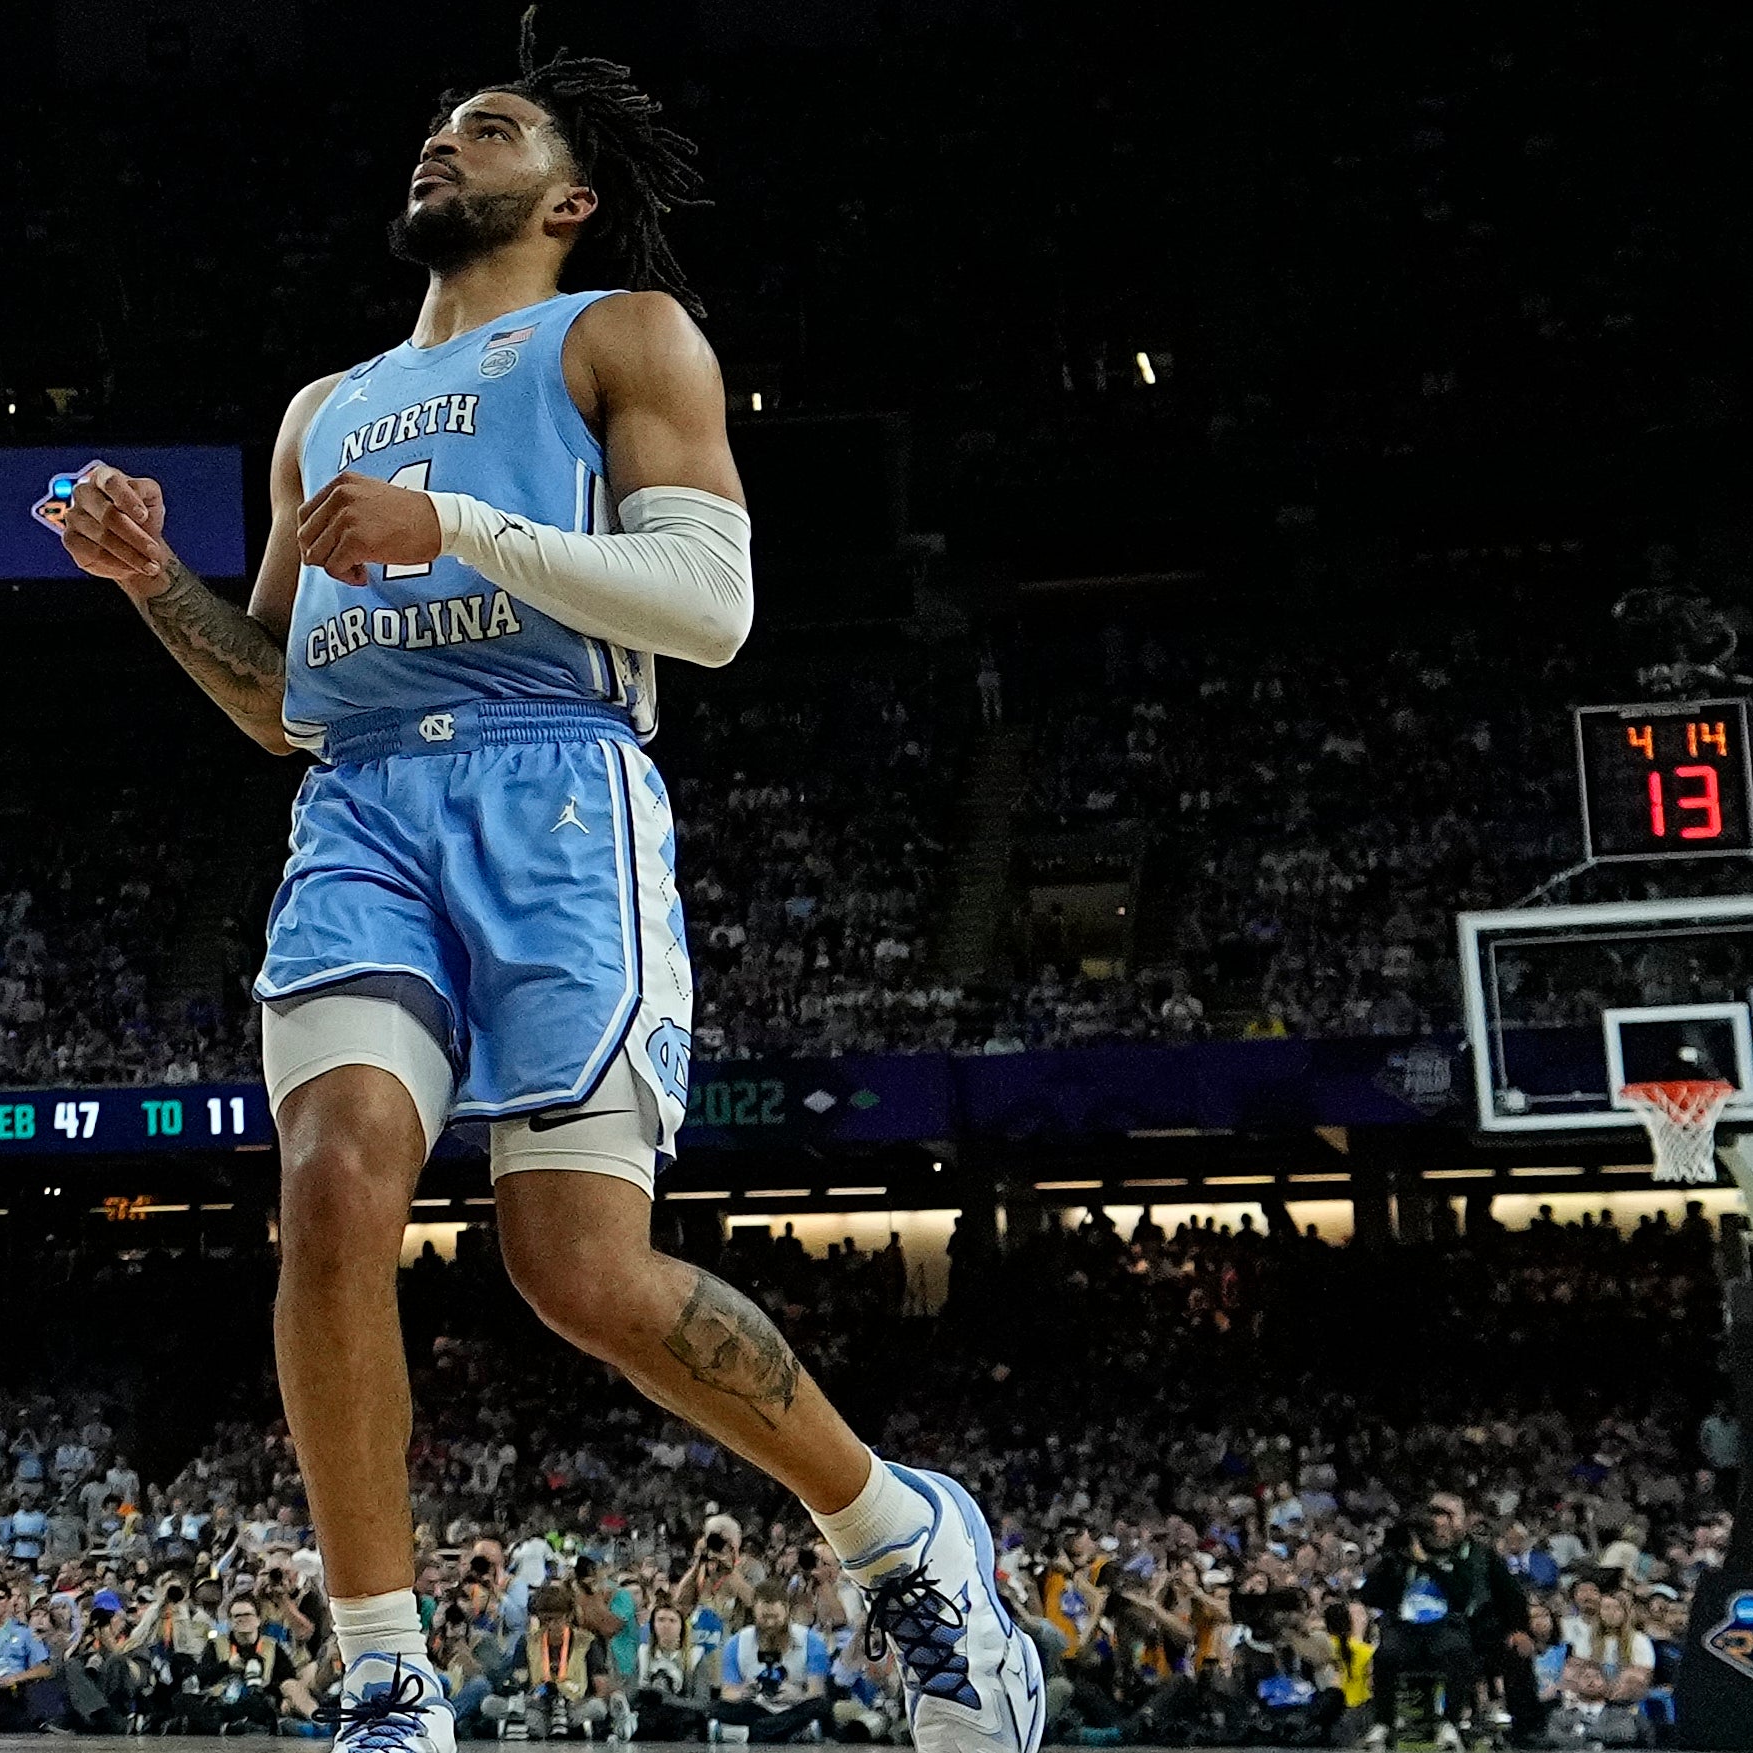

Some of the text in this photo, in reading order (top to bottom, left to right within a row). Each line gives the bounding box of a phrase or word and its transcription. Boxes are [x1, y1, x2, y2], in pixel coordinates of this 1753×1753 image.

[338, 393, 481, 472] NORTH
[306, 591, 523, 669] CAROLINA
[1647, 765, 1722, 839] 13
[53, 1101, 100, 1138] 47
[141, 1100, 183, 1136] TO
[207, 1097, 245, 1135] 11
